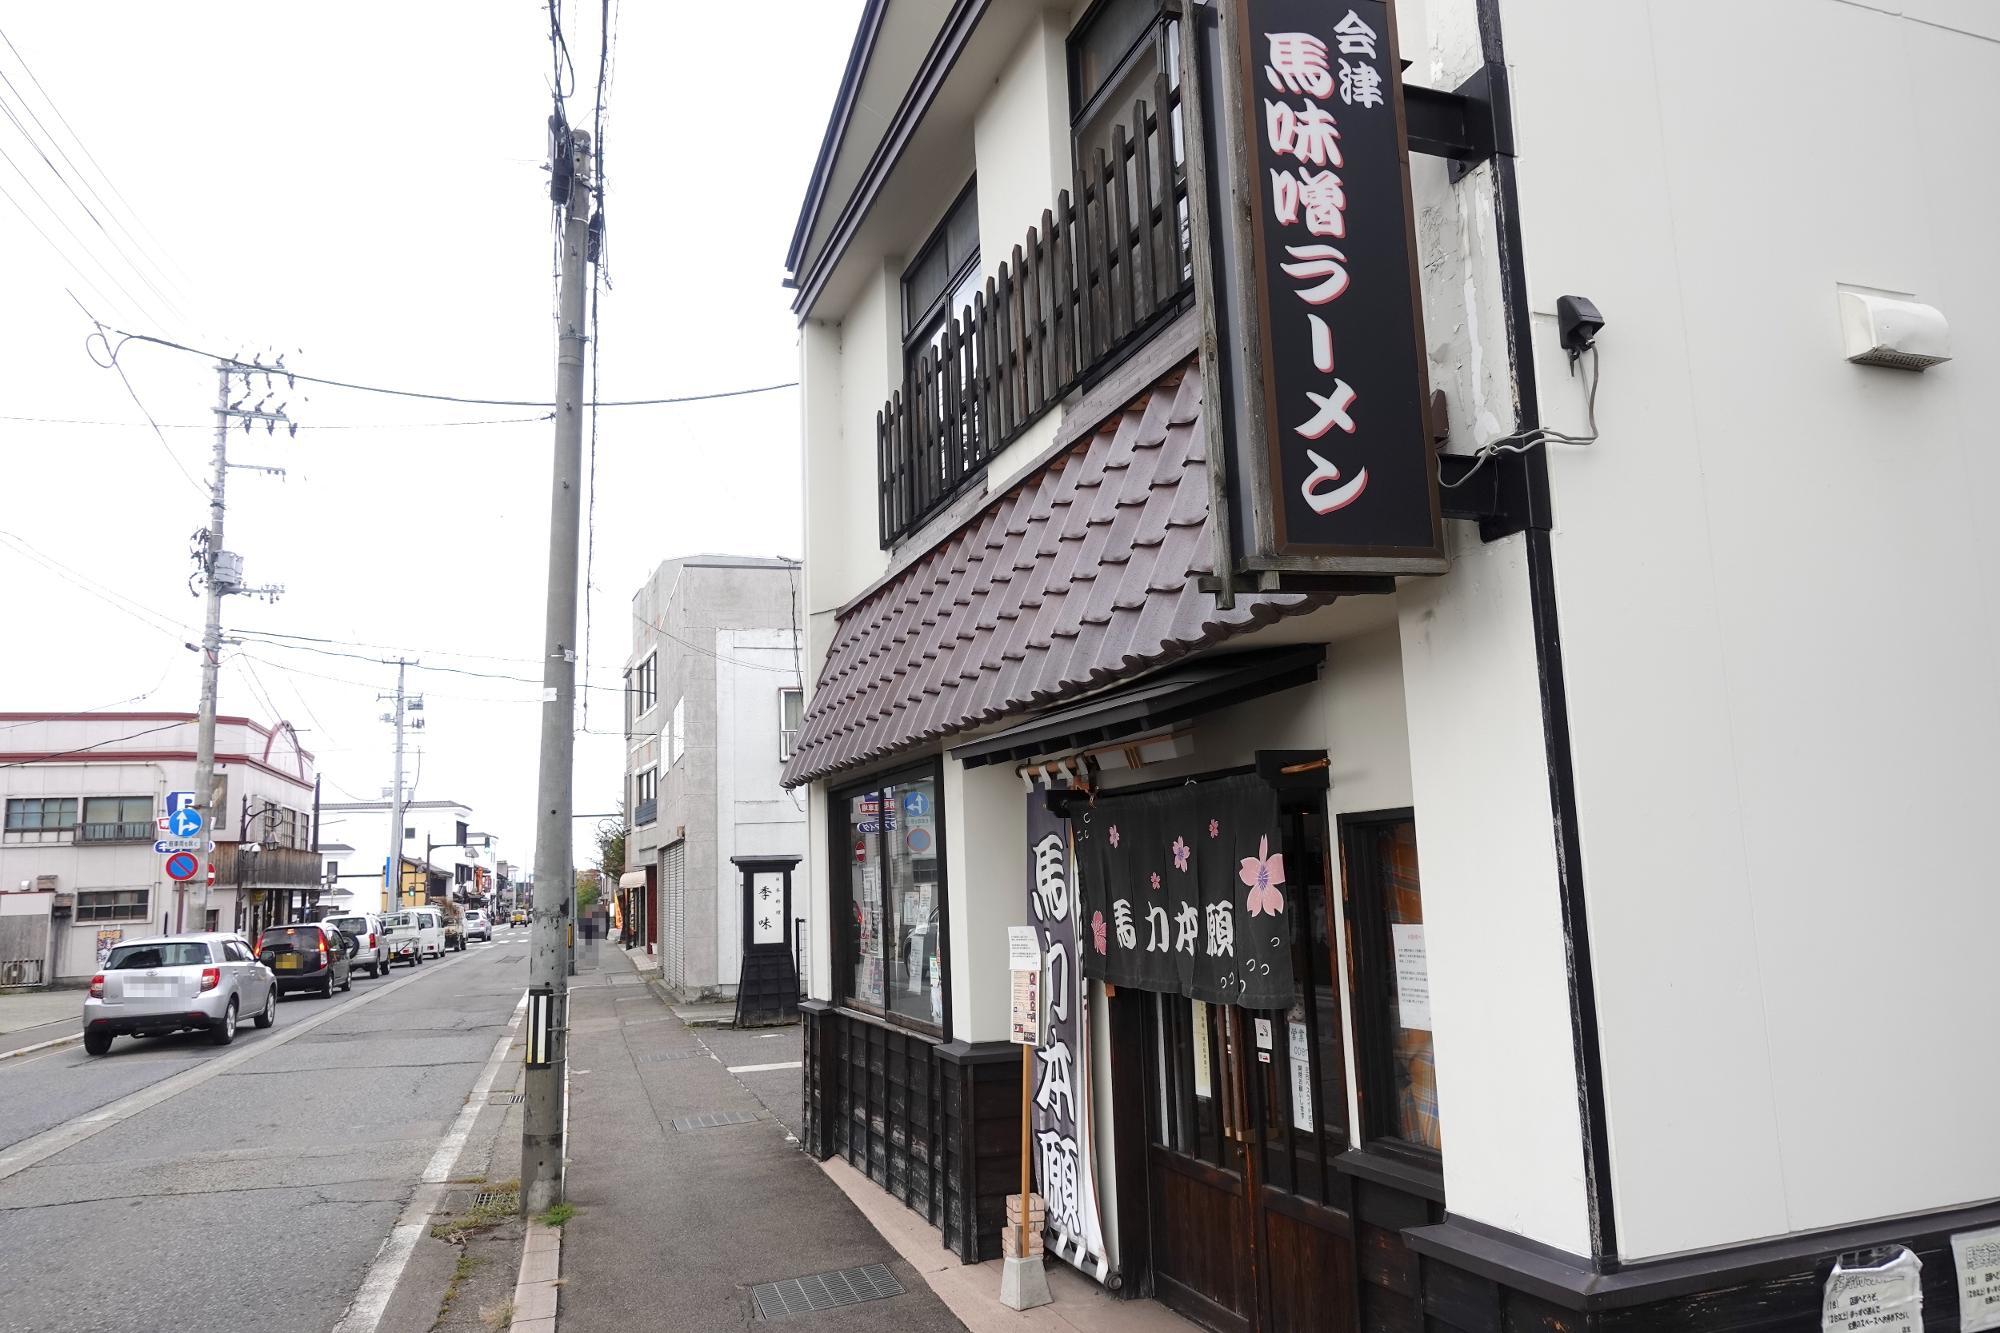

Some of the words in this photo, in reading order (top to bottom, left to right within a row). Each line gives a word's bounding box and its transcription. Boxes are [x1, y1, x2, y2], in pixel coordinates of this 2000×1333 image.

[1332, 9, 1384, 109] 会津
[1263, 31, 1369, 516] 馬味噌ラーメン
[1112, 898, 1234, 958] 馬力本願
